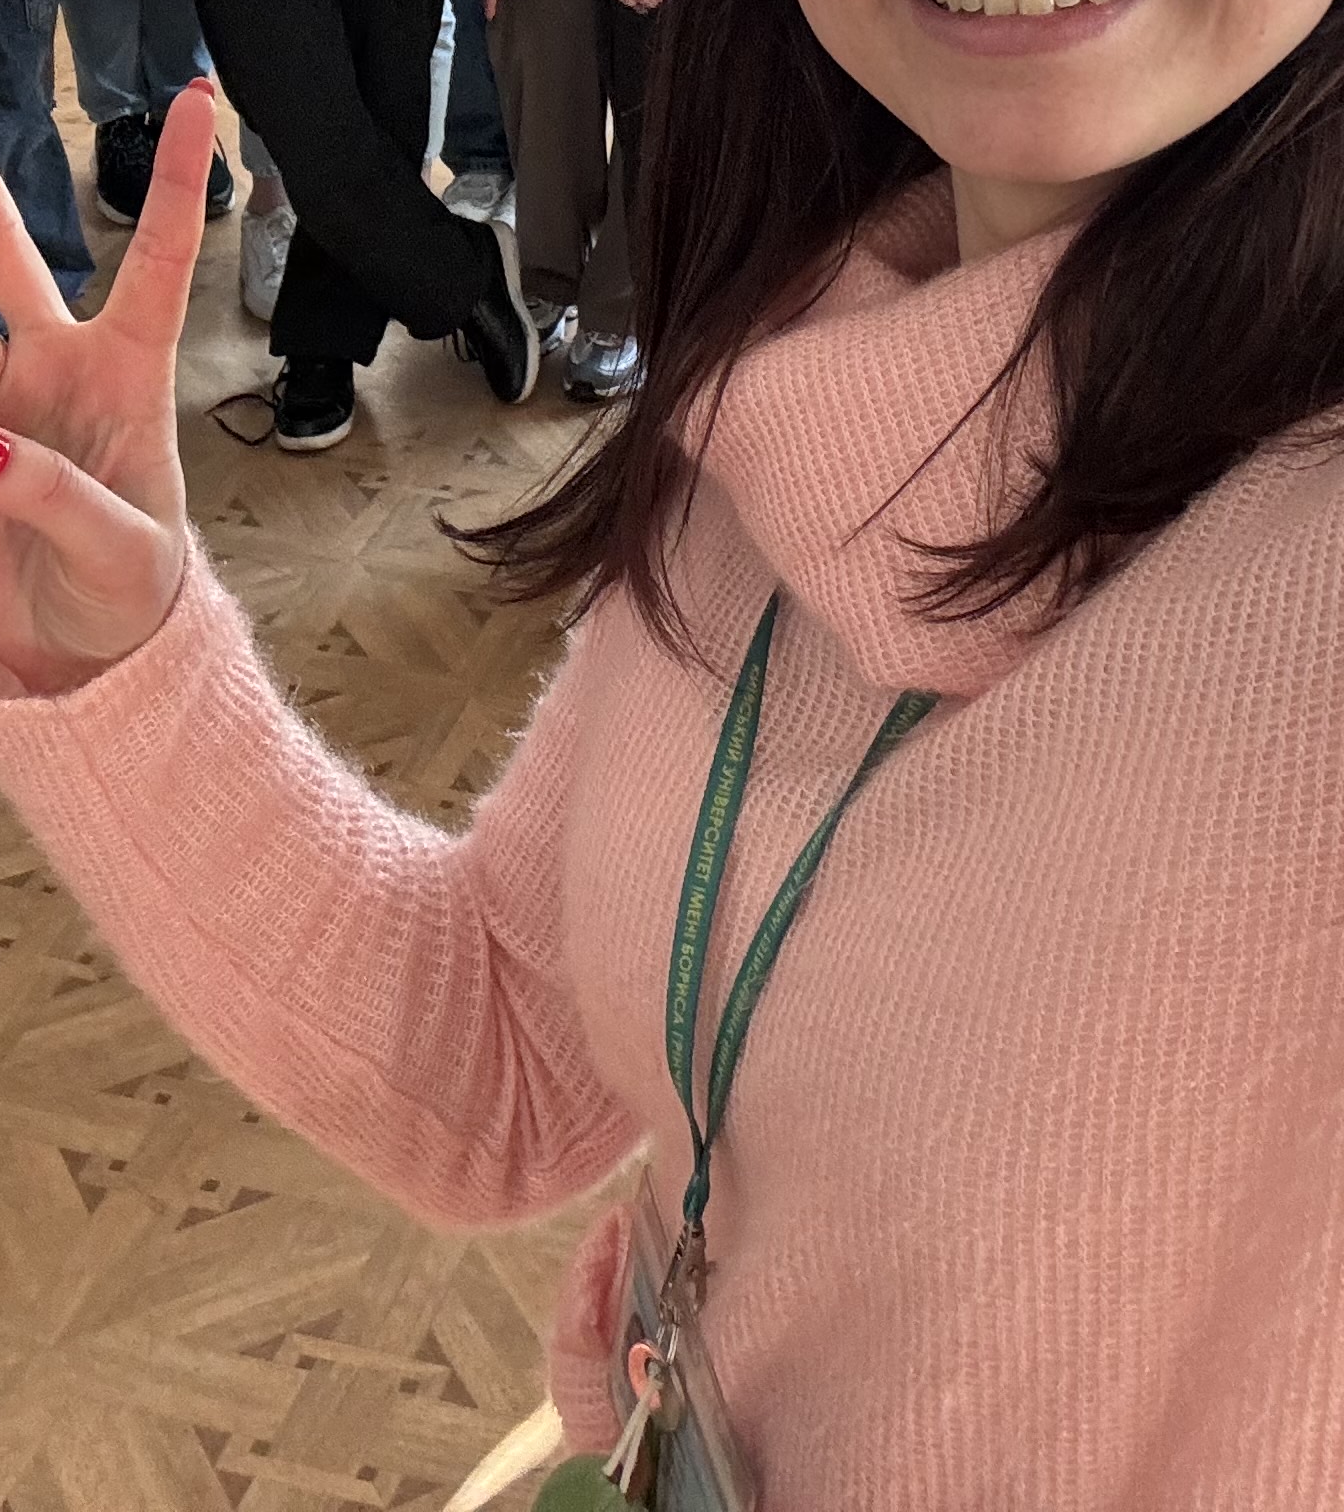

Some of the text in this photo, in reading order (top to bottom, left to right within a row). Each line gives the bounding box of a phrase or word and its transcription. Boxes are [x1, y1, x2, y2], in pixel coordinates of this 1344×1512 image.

[695, 763, 737, 883] УНІВЕРСИТЕТ
[682, 885, 707, 939] ІМЕНІ
[672, 944, 695, 1025] БОРИСА
